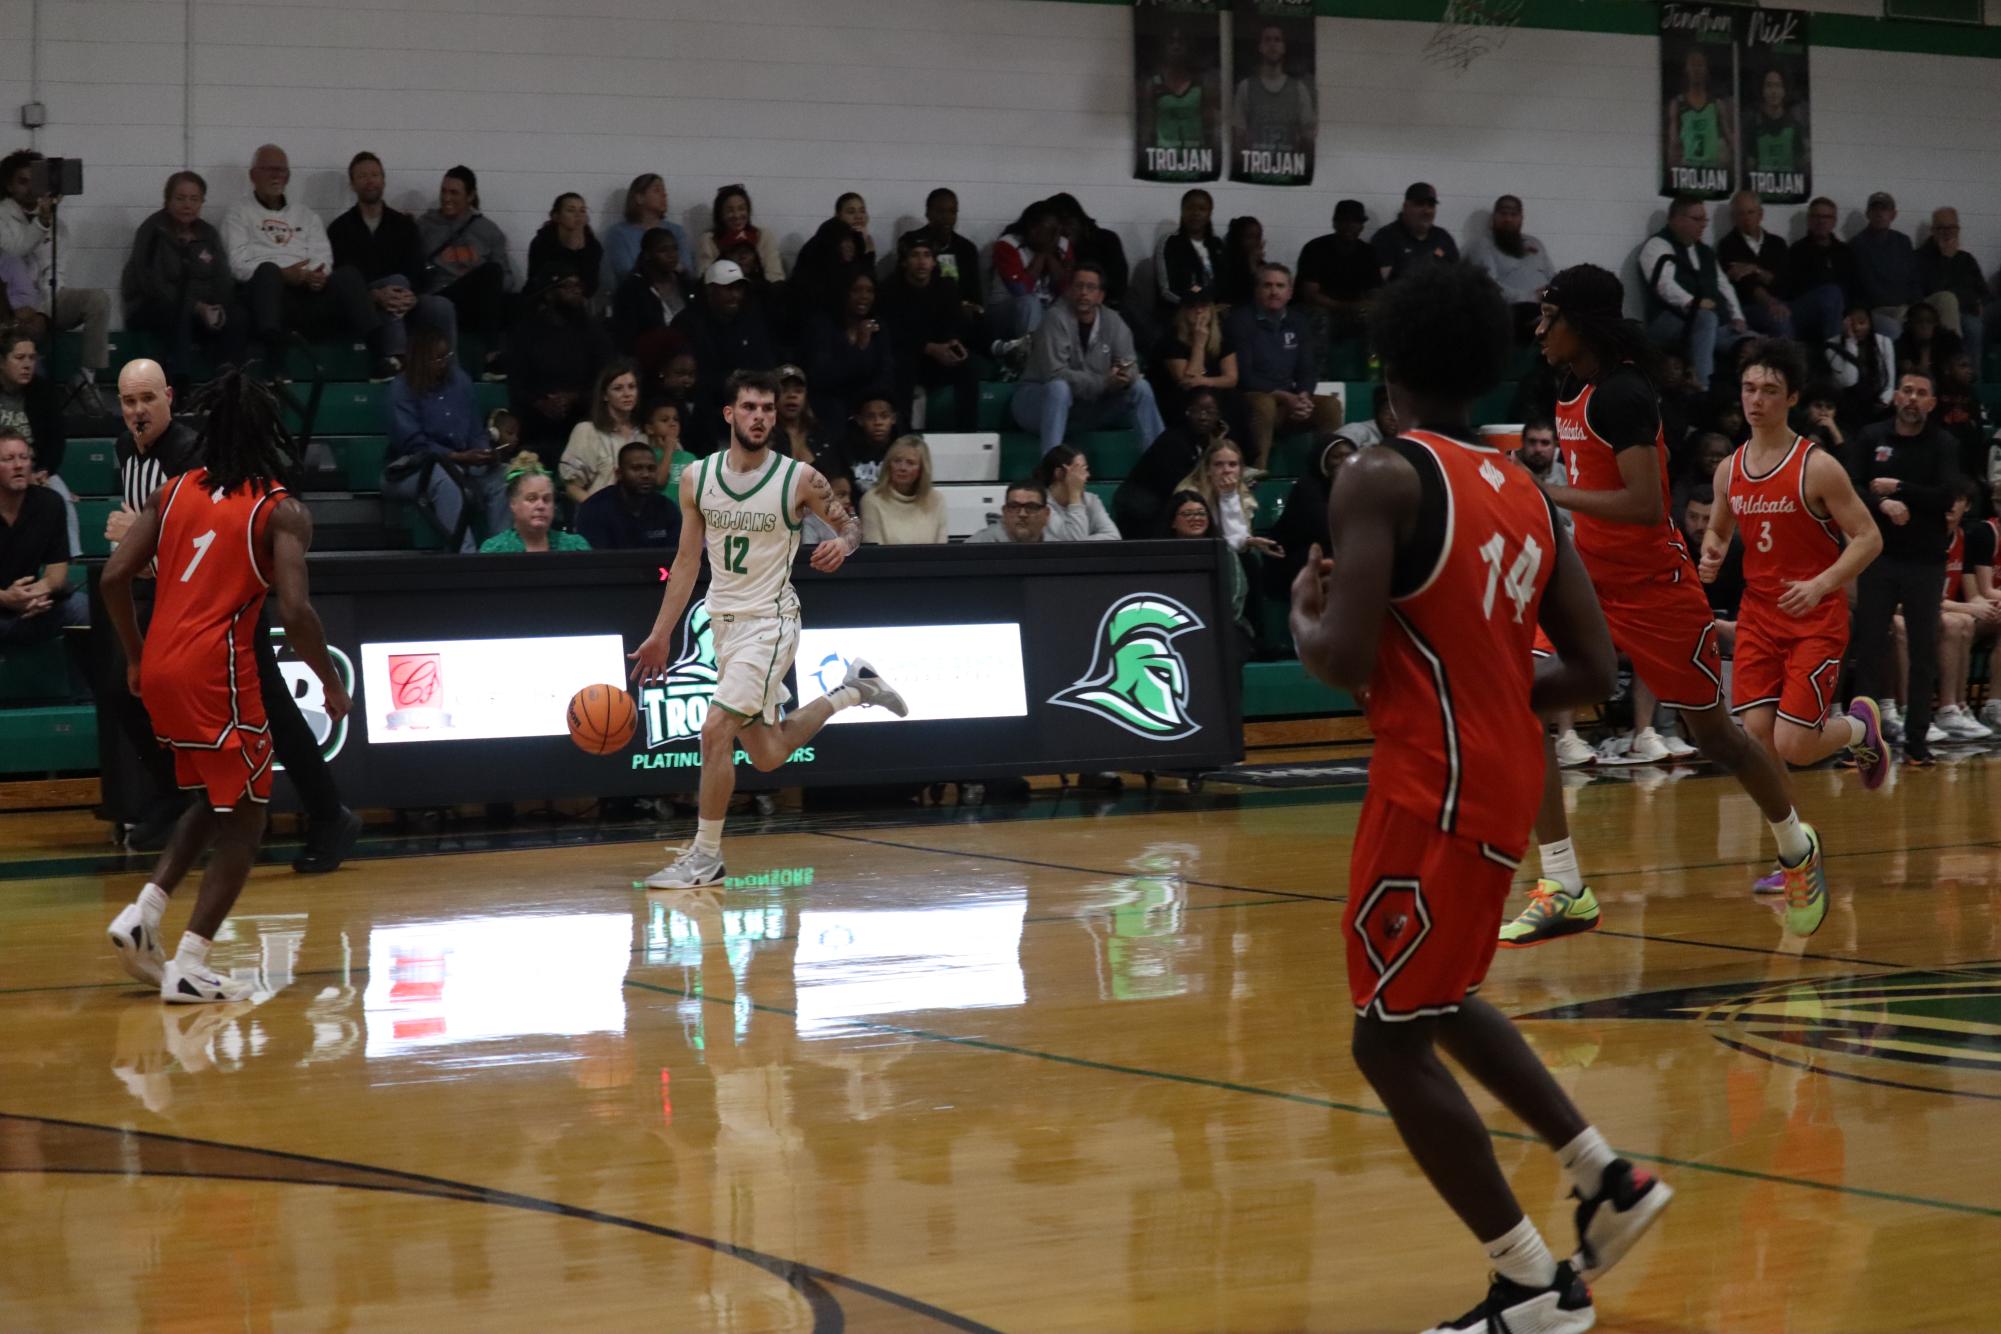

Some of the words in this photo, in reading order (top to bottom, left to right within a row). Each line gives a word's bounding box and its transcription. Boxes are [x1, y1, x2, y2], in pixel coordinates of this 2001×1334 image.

[1747, 10, 1799, 47] Nick
[1145, 147, 1213, 173] TROJAN
[1240, 150, 1307, 176] TROJAN
[1671, 167, 1728, 192] TROJAN
[1749, 172, 1805, 195] TROJAN
[1730, 494, 1797, 515] Wildcats
[702, 508, 776, 533] TROJANS
[1756, 521, 1773, 553] 3
[180, 529, 217, 583] 1
[724, 535, 750, 575] 12
[1478, 532, 1543, 625] 14
[632, 751, 704, 769] PLATINU
